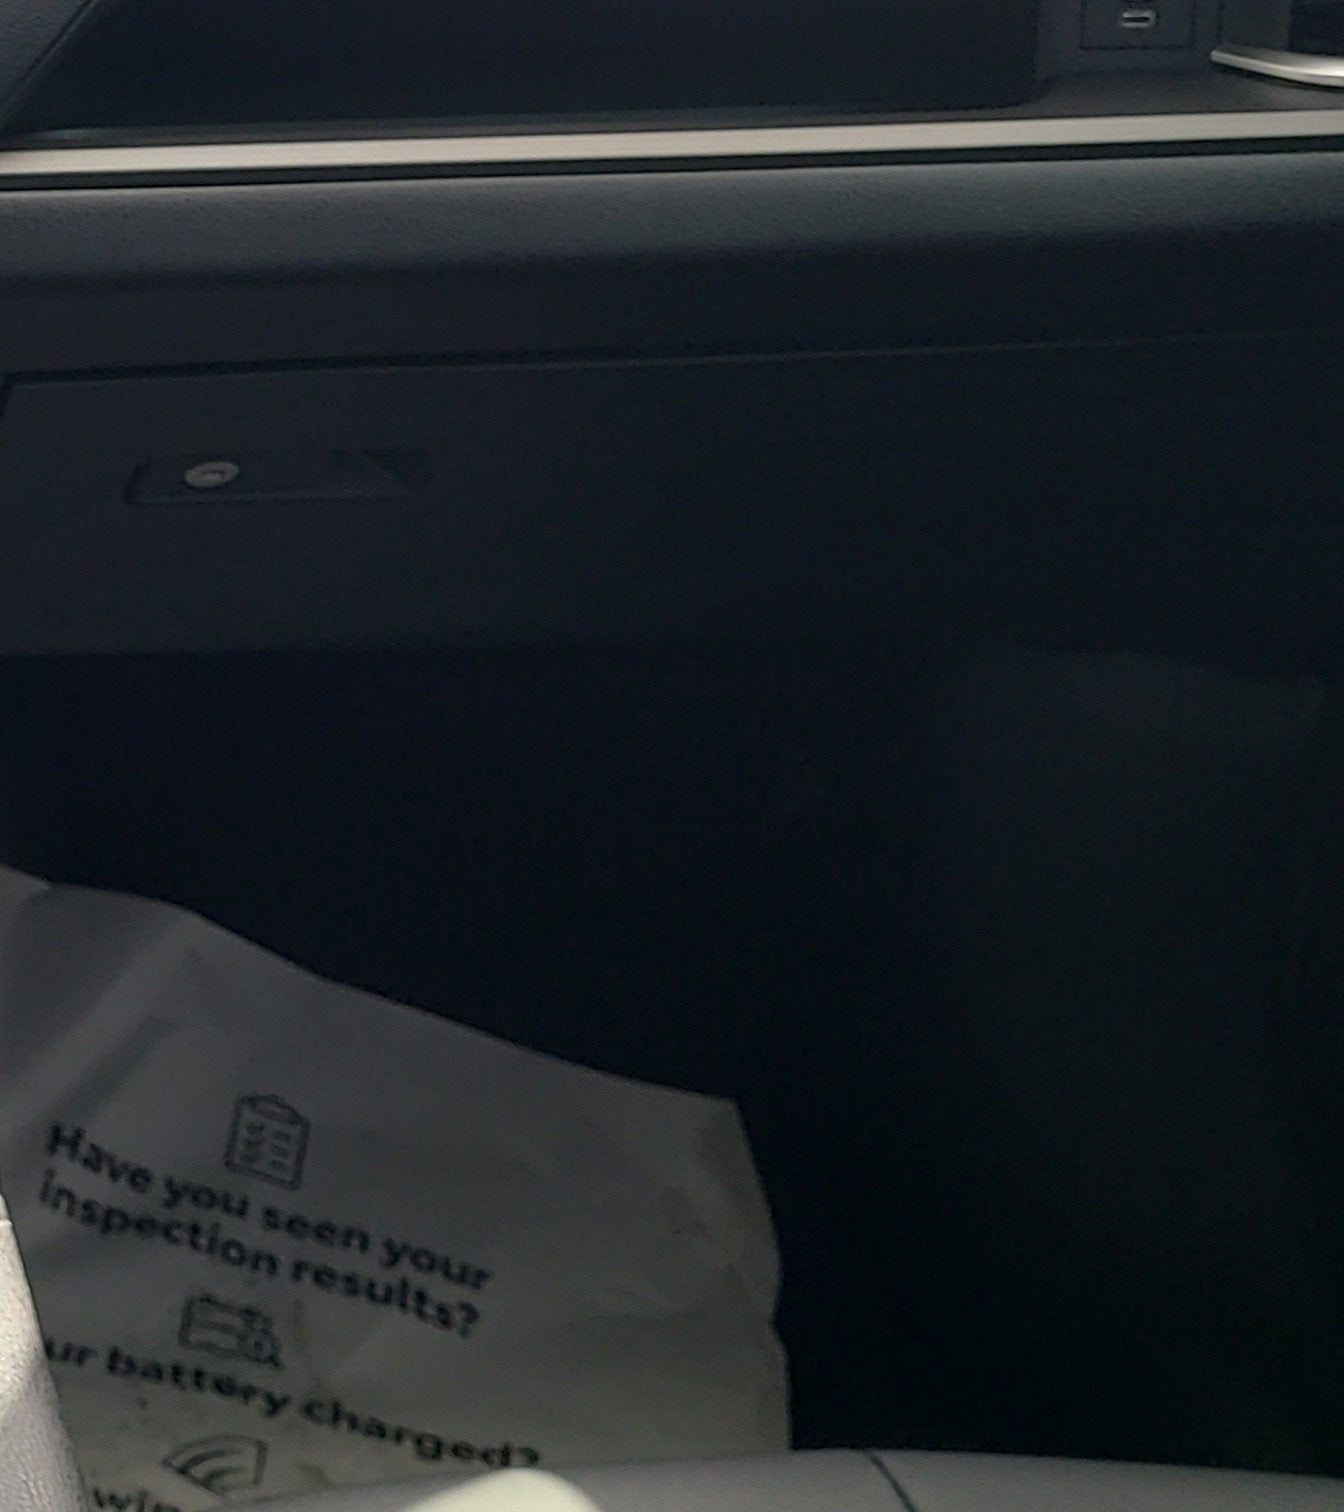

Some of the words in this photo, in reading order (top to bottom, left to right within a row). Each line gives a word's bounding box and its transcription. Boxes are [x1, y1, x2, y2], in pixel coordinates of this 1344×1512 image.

[37, 1168, 280, 1281] inspection
[291, 1259, 482, 1339] results?
[43, 1122, 154, 1192] Have
[162, 1176, 249, 1221] you
[263, 1203, 371, 1254] seen
[381, 1236, 494, 1291] your
[107, 1343, 292, 1419] battery
[299, 1396, 540, 1470] charged?
